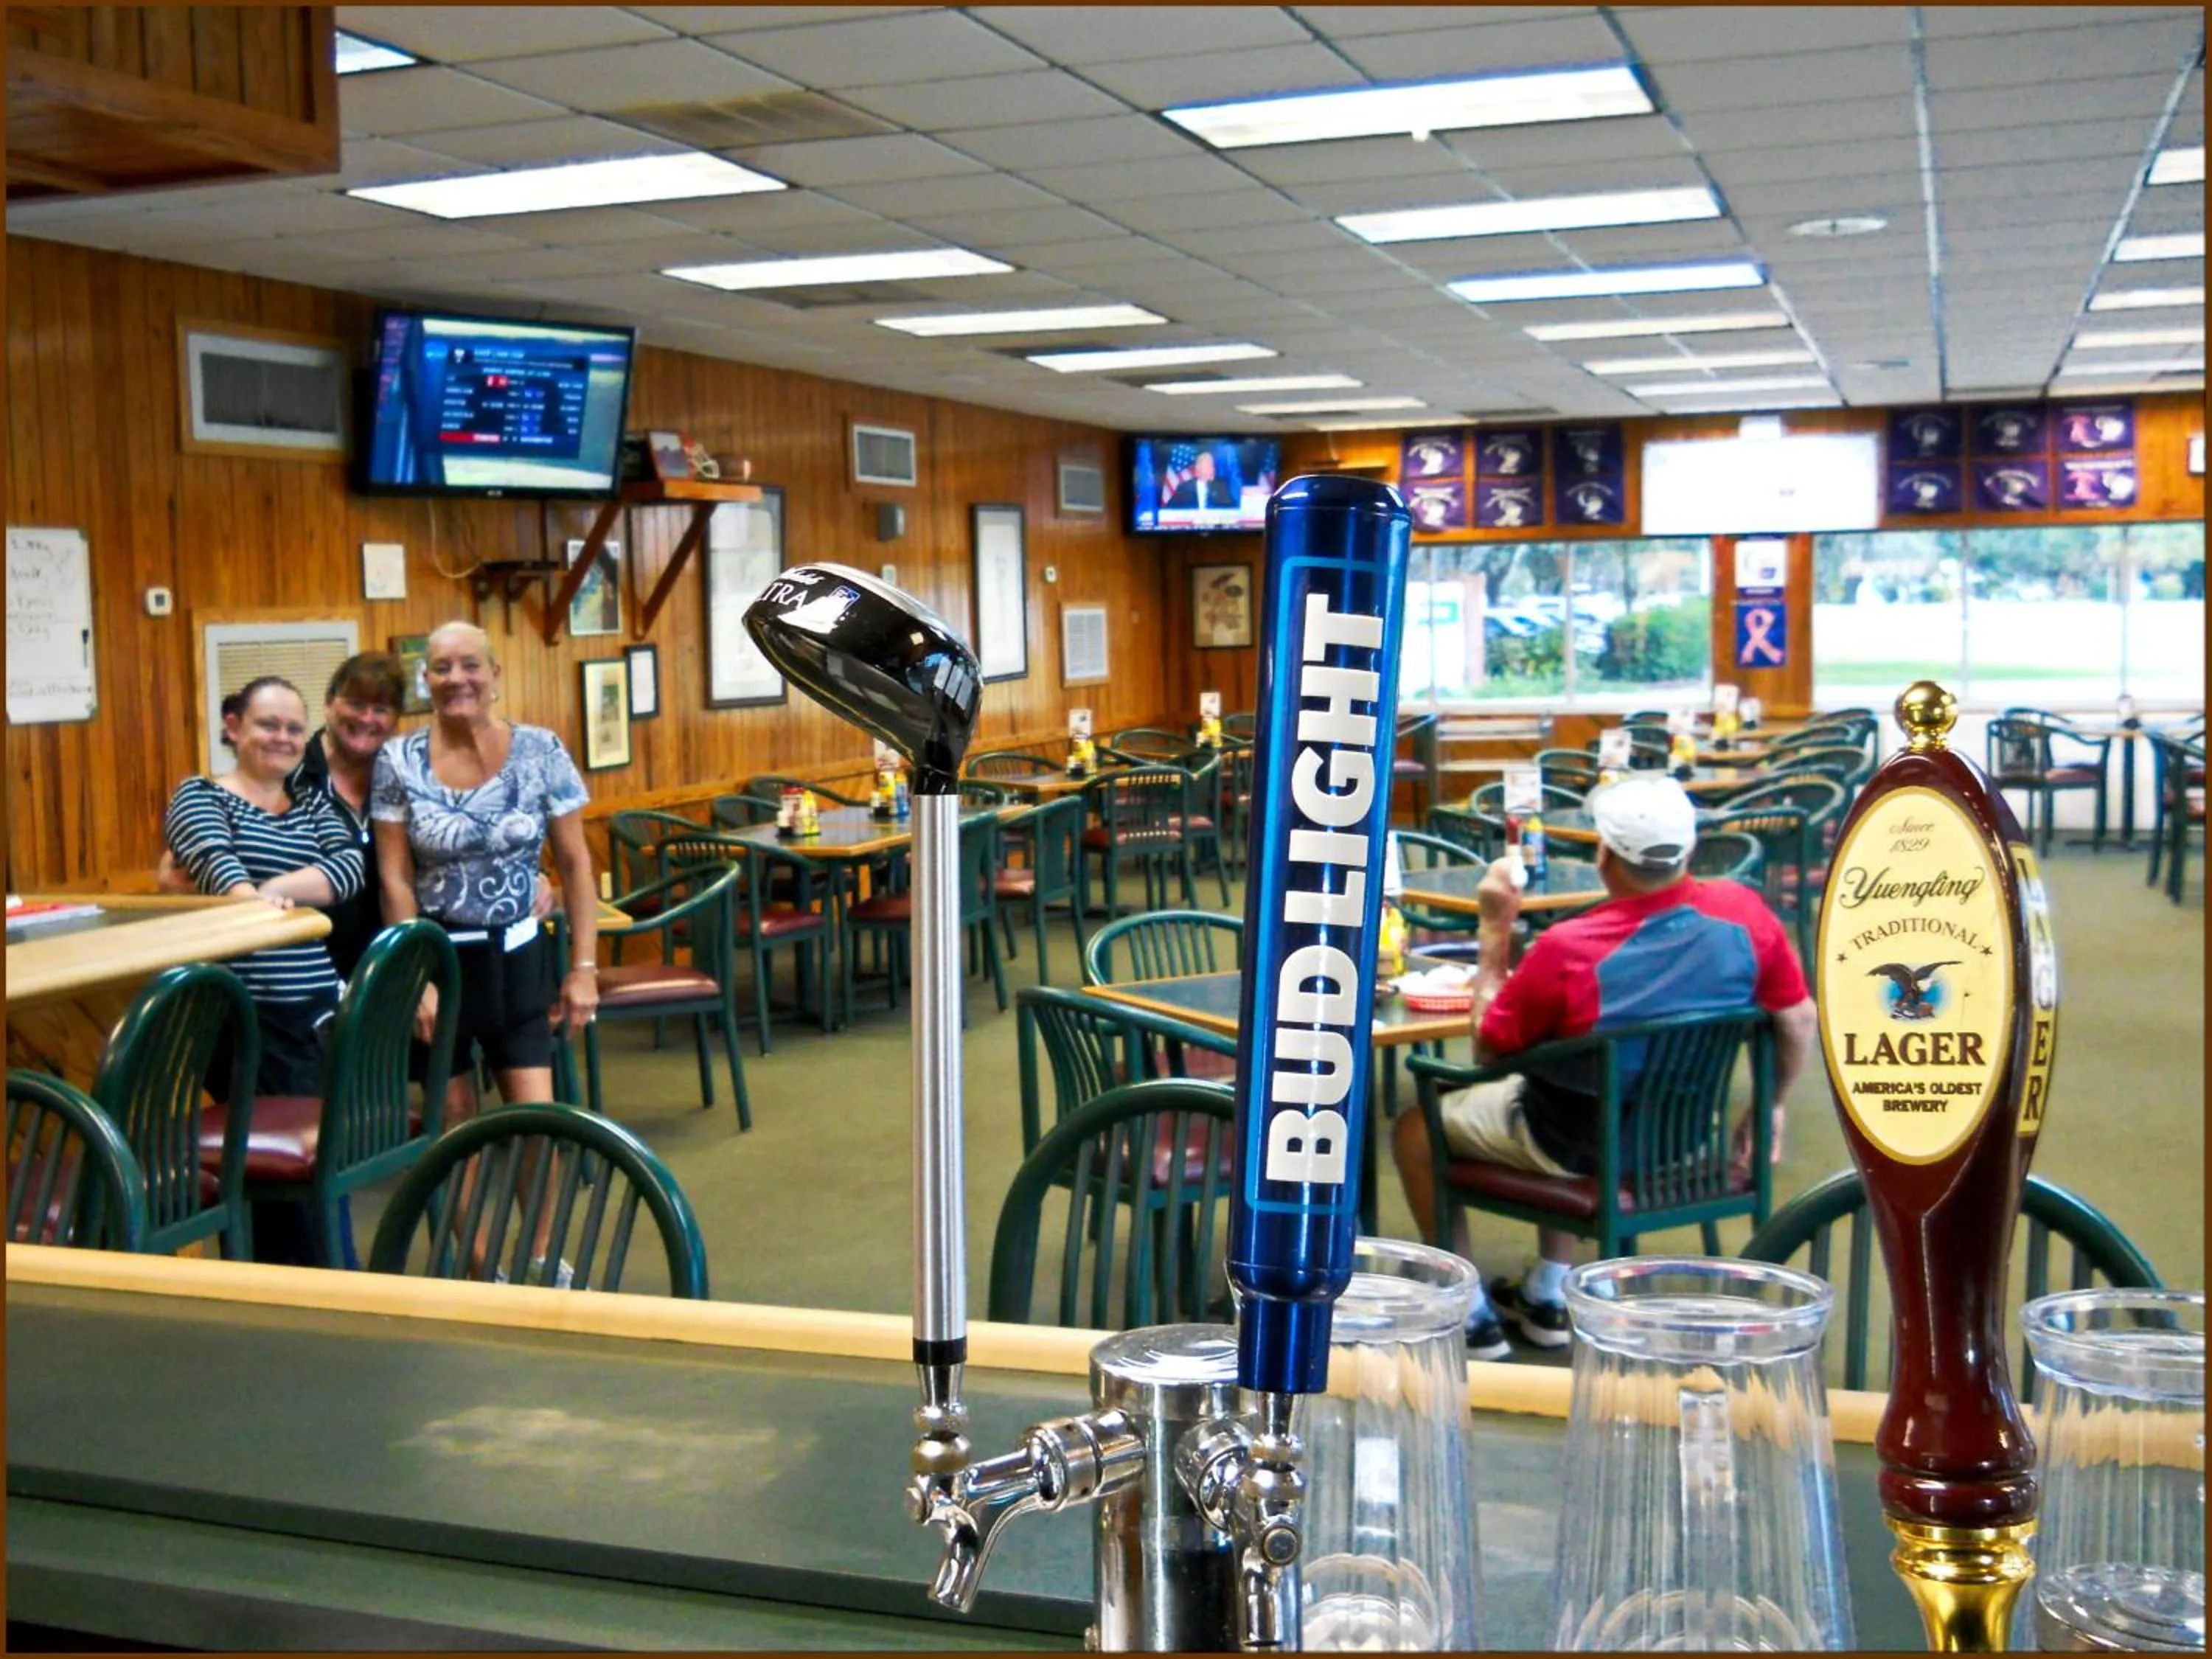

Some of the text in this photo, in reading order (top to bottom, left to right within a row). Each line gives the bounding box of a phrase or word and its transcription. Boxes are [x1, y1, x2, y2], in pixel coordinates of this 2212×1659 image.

[754, 581, 809, 611] TRA
[1888, 815, 1935, 835] Since
[1889, 837, 1930, 853] 1829
[1266, 593, 1384, 1184] BUD LIGHT
[1838, 866, 1986, 909] Yuengling
[1851, 917, 1978, 950] TRADITIONAL
[1844, 1032, 1986, 1066] LAGER
[1852, 1082, 1982, 1095] AMERICA'S OLDEST
[1882, 1099, 1949, 1113] BREWERY
